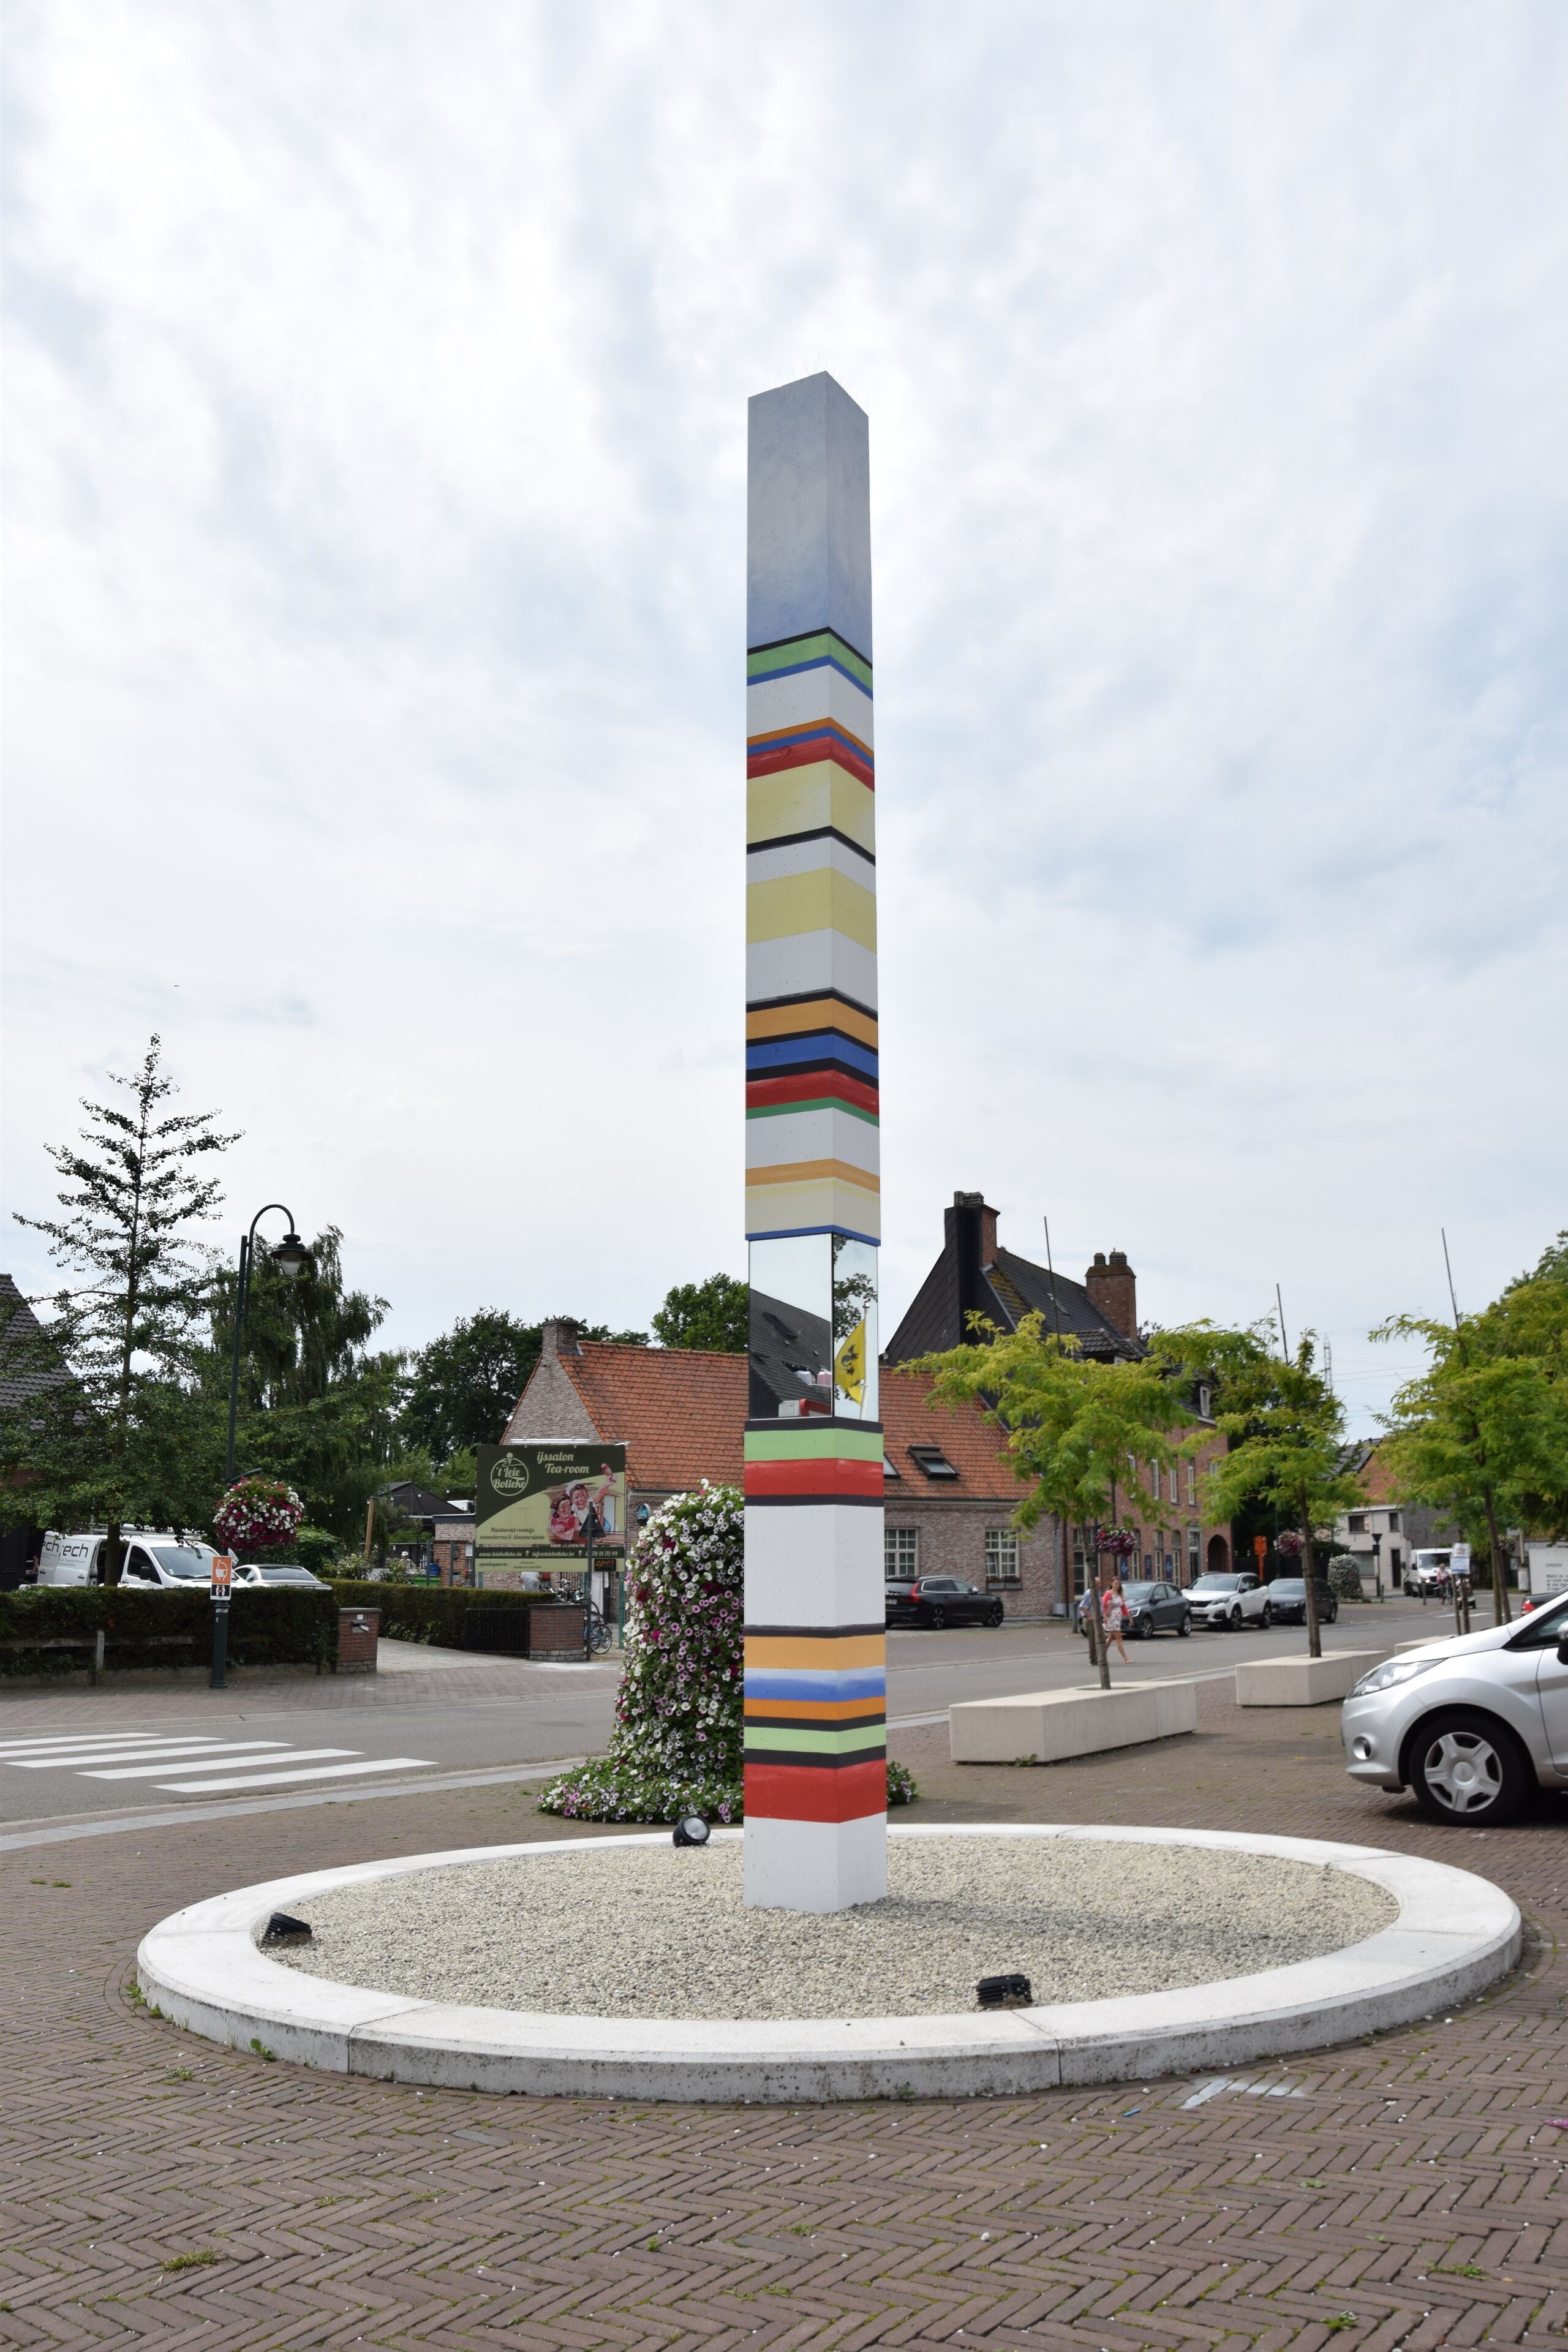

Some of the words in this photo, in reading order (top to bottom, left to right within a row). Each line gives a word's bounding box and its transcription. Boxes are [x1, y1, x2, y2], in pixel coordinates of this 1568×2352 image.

[537, 1452, 574, 1464] ijssalon
[545, 1463, 589, 1474] Tea-room
[492, 1479, 526, 1488] Bolleke
